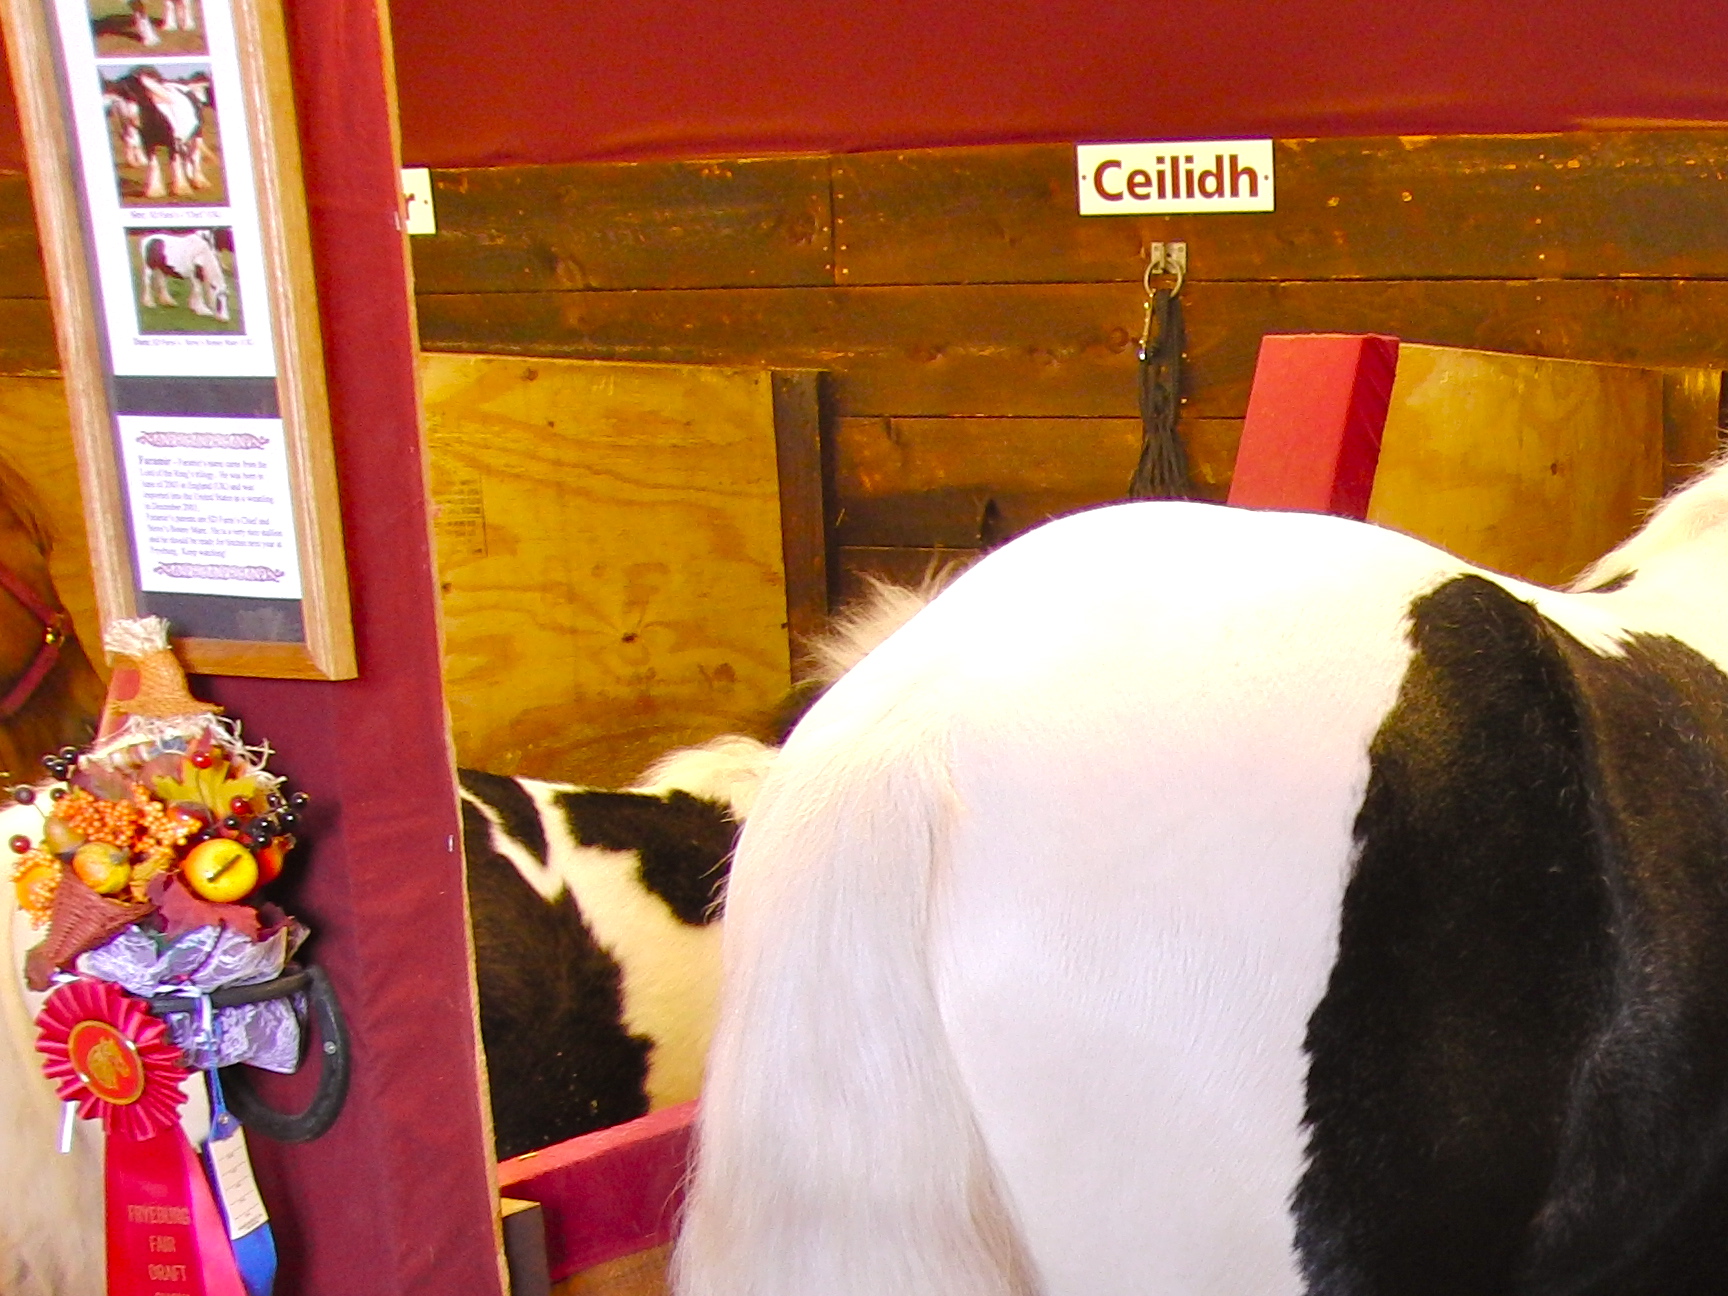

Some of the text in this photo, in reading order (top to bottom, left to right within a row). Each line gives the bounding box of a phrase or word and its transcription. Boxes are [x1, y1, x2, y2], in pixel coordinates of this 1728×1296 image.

[1093, 153, 1259, 202] Ceilidh
[148, 1235, 177, 1253] FAIR
[147, 1264, 187, 1282] DRAFT
